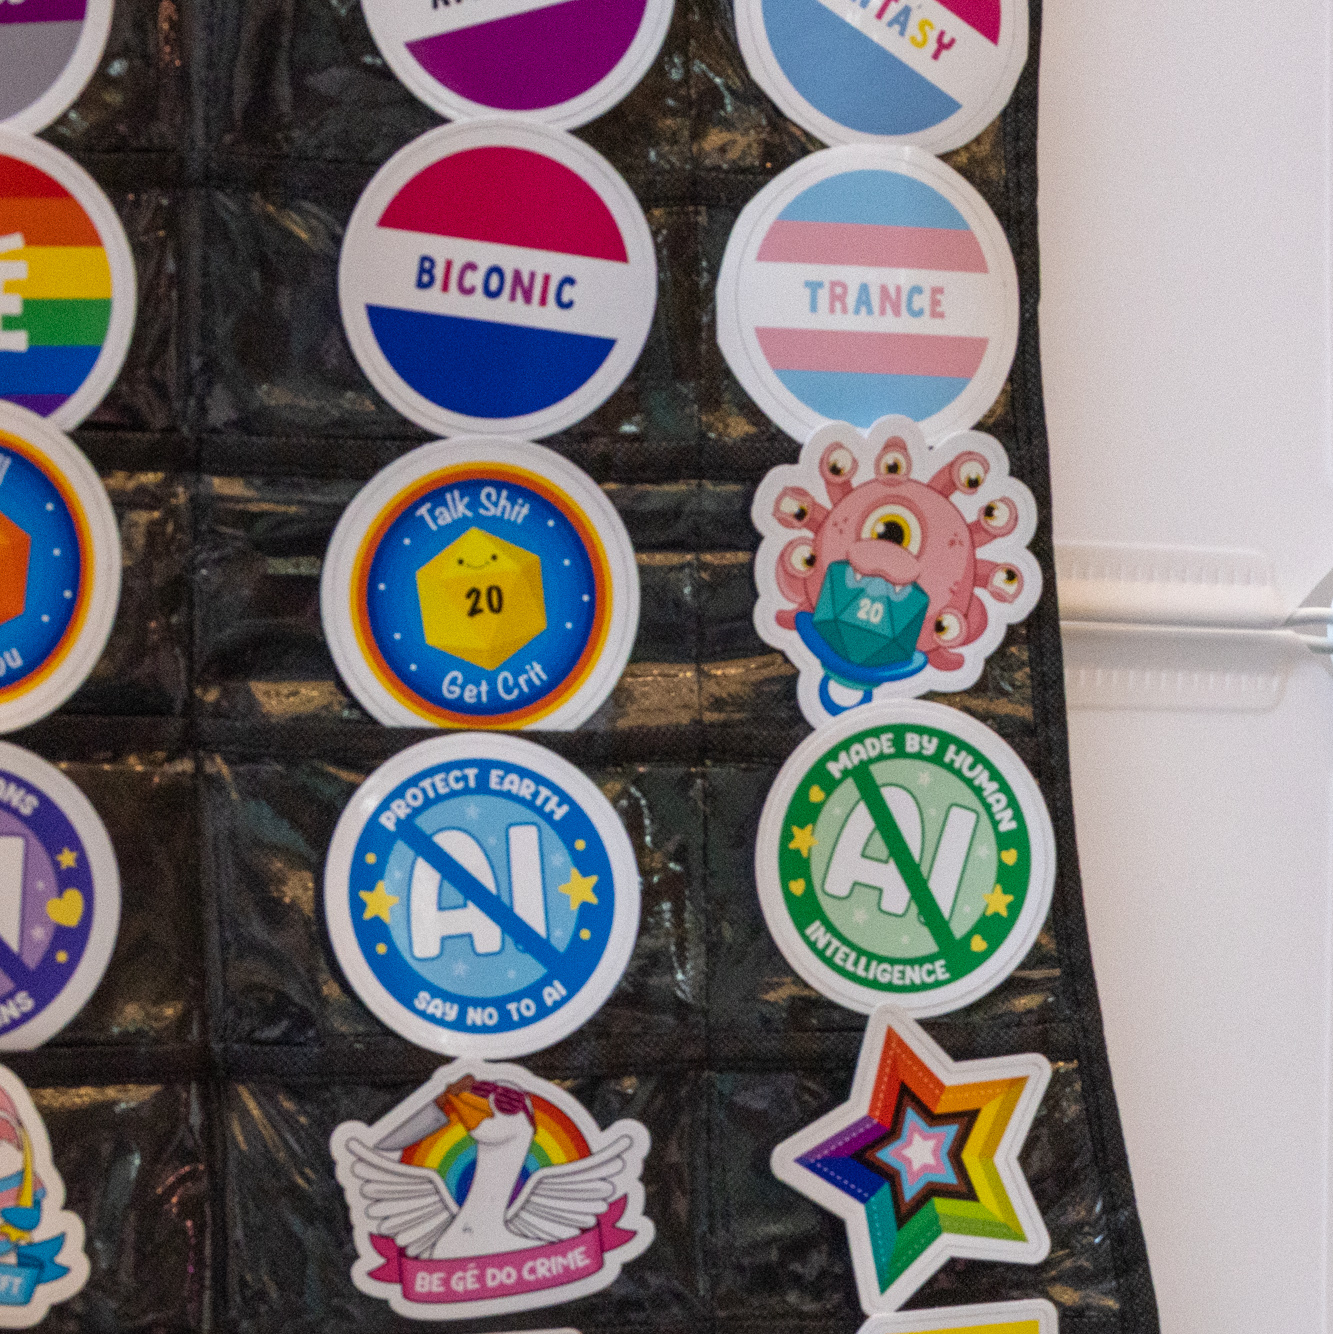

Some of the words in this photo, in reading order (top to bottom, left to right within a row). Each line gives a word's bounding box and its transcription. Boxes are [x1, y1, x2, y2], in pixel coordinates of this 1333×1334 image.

[415, 255, 577, 310] BICONIC
[804, 280, 946, 320] TRANCE
[415, 487, 474, 532] Talk
[481, 485, 531, 526] Shit
[465, 585, 503, 618] 20
[856, 599, 884, 624] 20
[440, 671, 490, 704] Get
[497, 661, 548, 702] Crit
[379, 767, 479, 832] PROTECT
[488, 769, 571, 821] EARTH
[825, 732, 895, 781] MADE
[904, 732, 939, 757] BY
[943, 743, 1018, 833] HUMAN
[804, 919, 950, 985] INTELLIGENCE
[413, 989, 459, 1025] SAY
[466, 1006, 499, 1027] NO
[506, 998, 536, 1021] TO
[541, 980, 567, 1006] AI
[414, 1269, 444, 1295] BE
[485, 1261, 517, 1287] DO
[521, 1246, 592, 1283] CRIME
